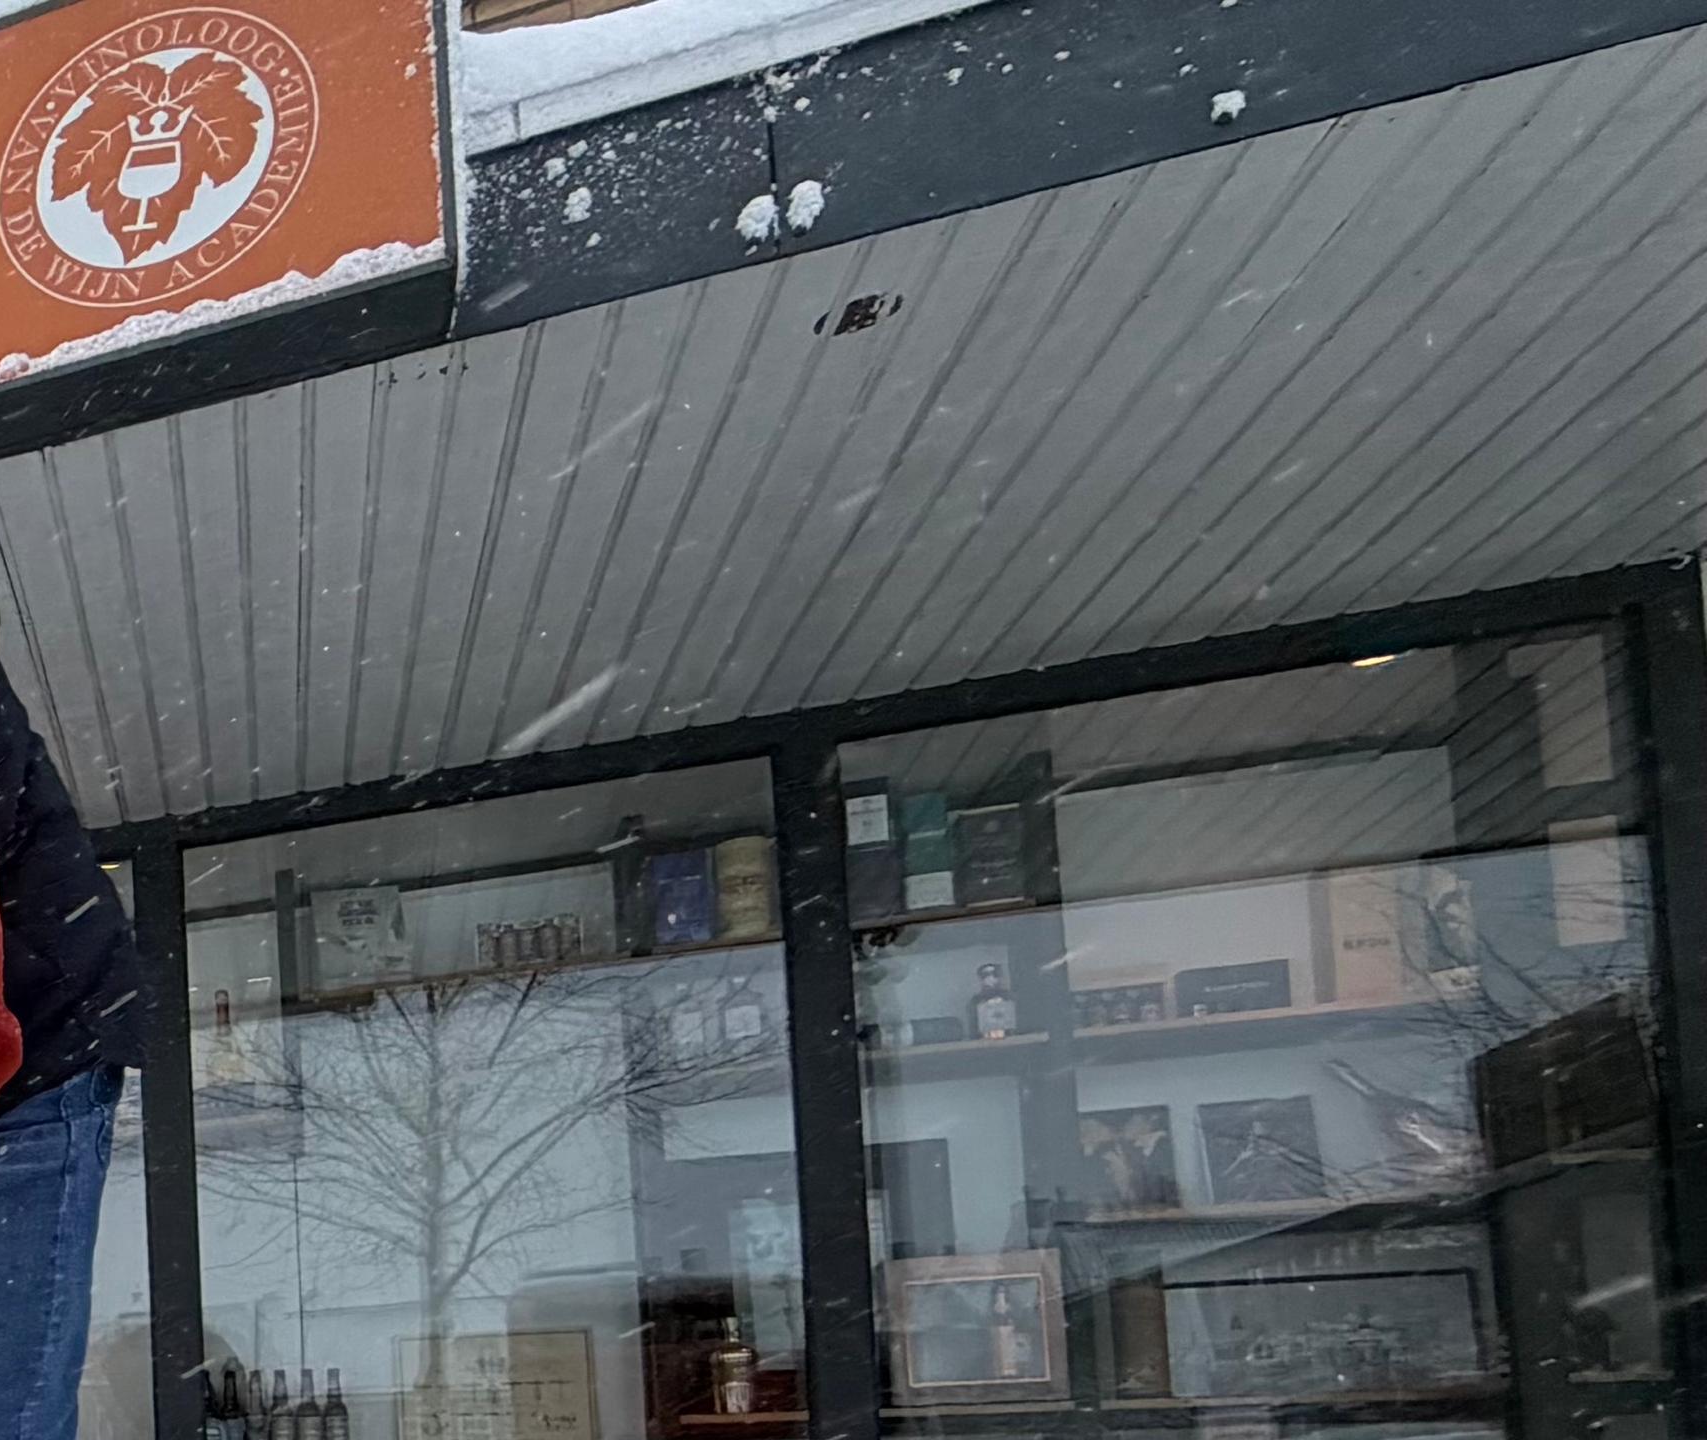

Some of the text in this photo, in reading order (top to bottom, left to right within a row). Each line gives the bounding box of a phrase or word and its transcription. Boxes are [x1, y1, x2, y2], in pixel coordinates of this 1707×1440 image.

[50, 17, 286, 98] VINOLOOG
[3, 73, 310, 299] VAN DE WIJN ACADEMIE
